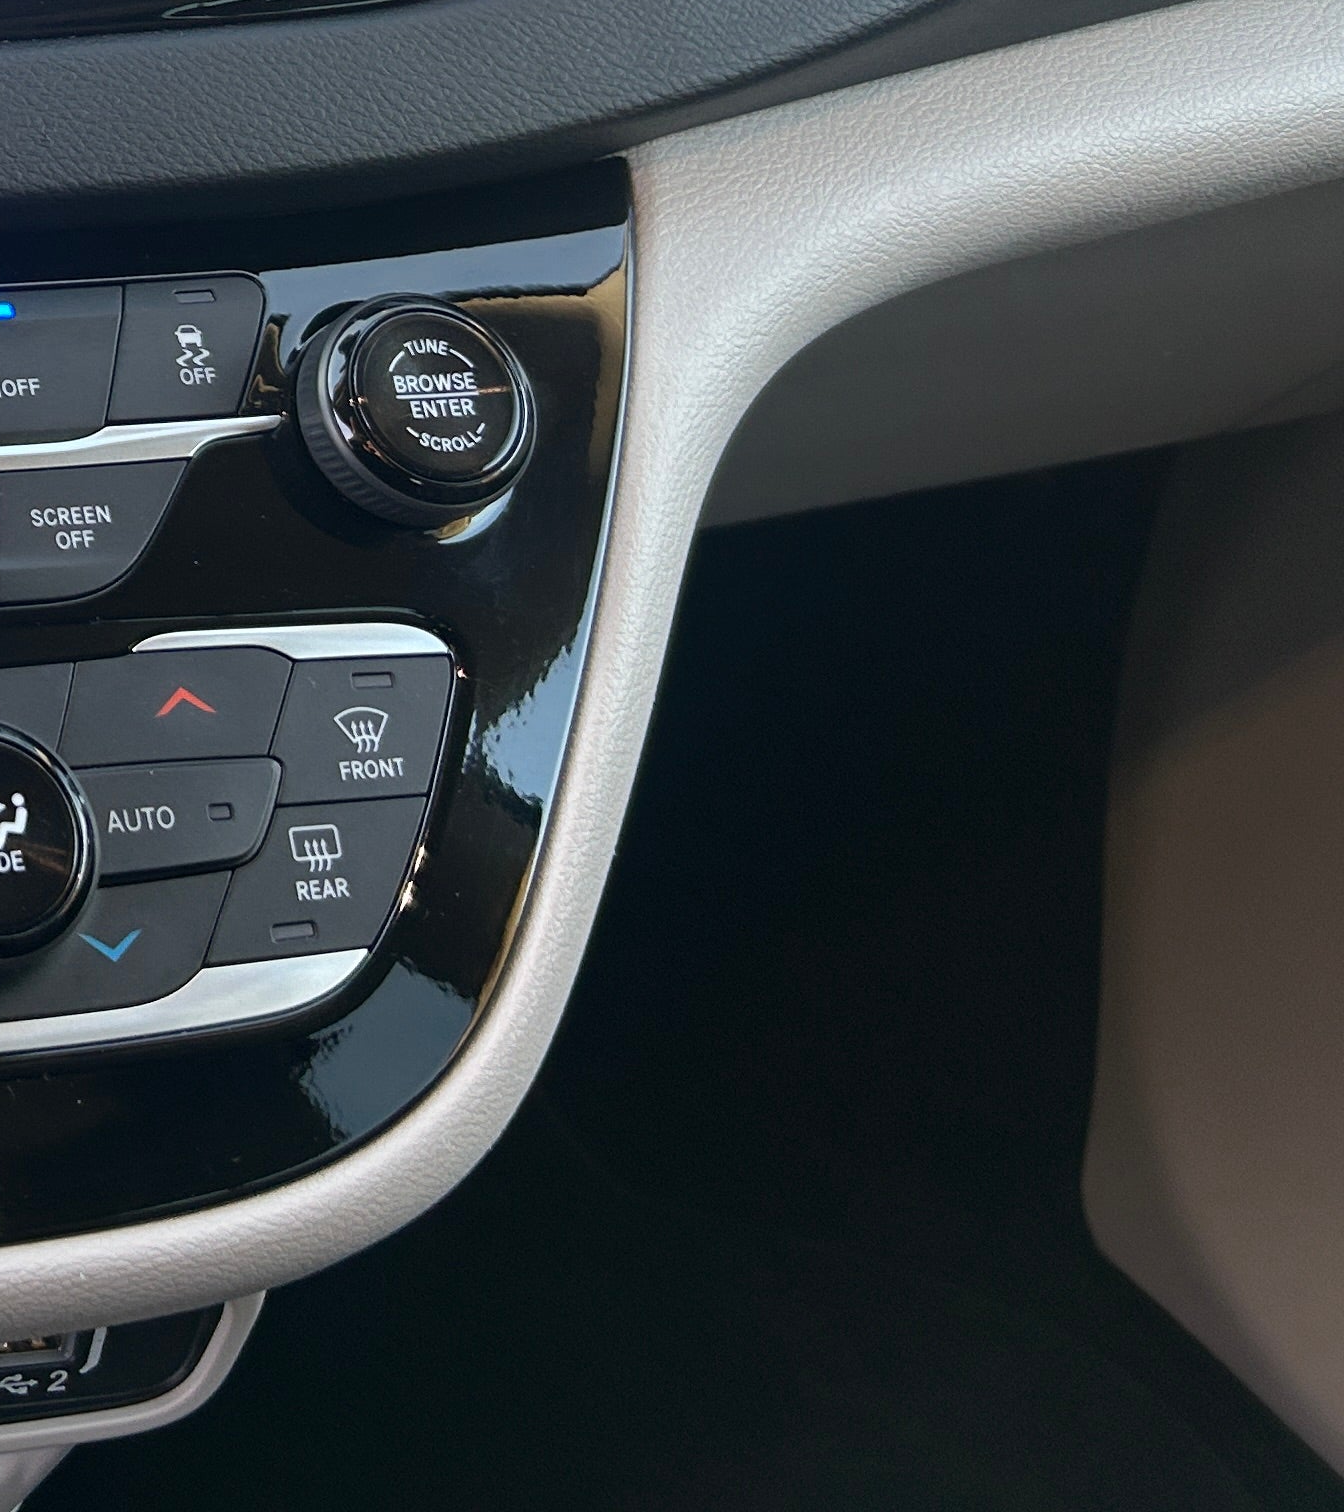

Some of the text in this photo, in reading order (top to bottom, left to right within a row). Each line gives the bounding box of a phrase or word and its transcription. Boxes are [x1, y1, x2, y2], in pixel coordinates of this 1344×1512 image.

[403, 338, 449, 357] TUNE
[2, 377, 41, 397] OFF
[179, 367, 216, 386] OFF
[393, 372, 478, 394] BROWSE
[409, 398, 477, 420] ENTER
[419, 430, 483, 453] SCROLL
[30, 504, 112, 530] SCREEN
[55, 528, 95, 551] OFF
[339, 757, 405, 781] FRONT
[107, 805, 175, 833] AUTO
[295, 877, 351, 901] REAR
[47, 1369, 69, 1393] 2
